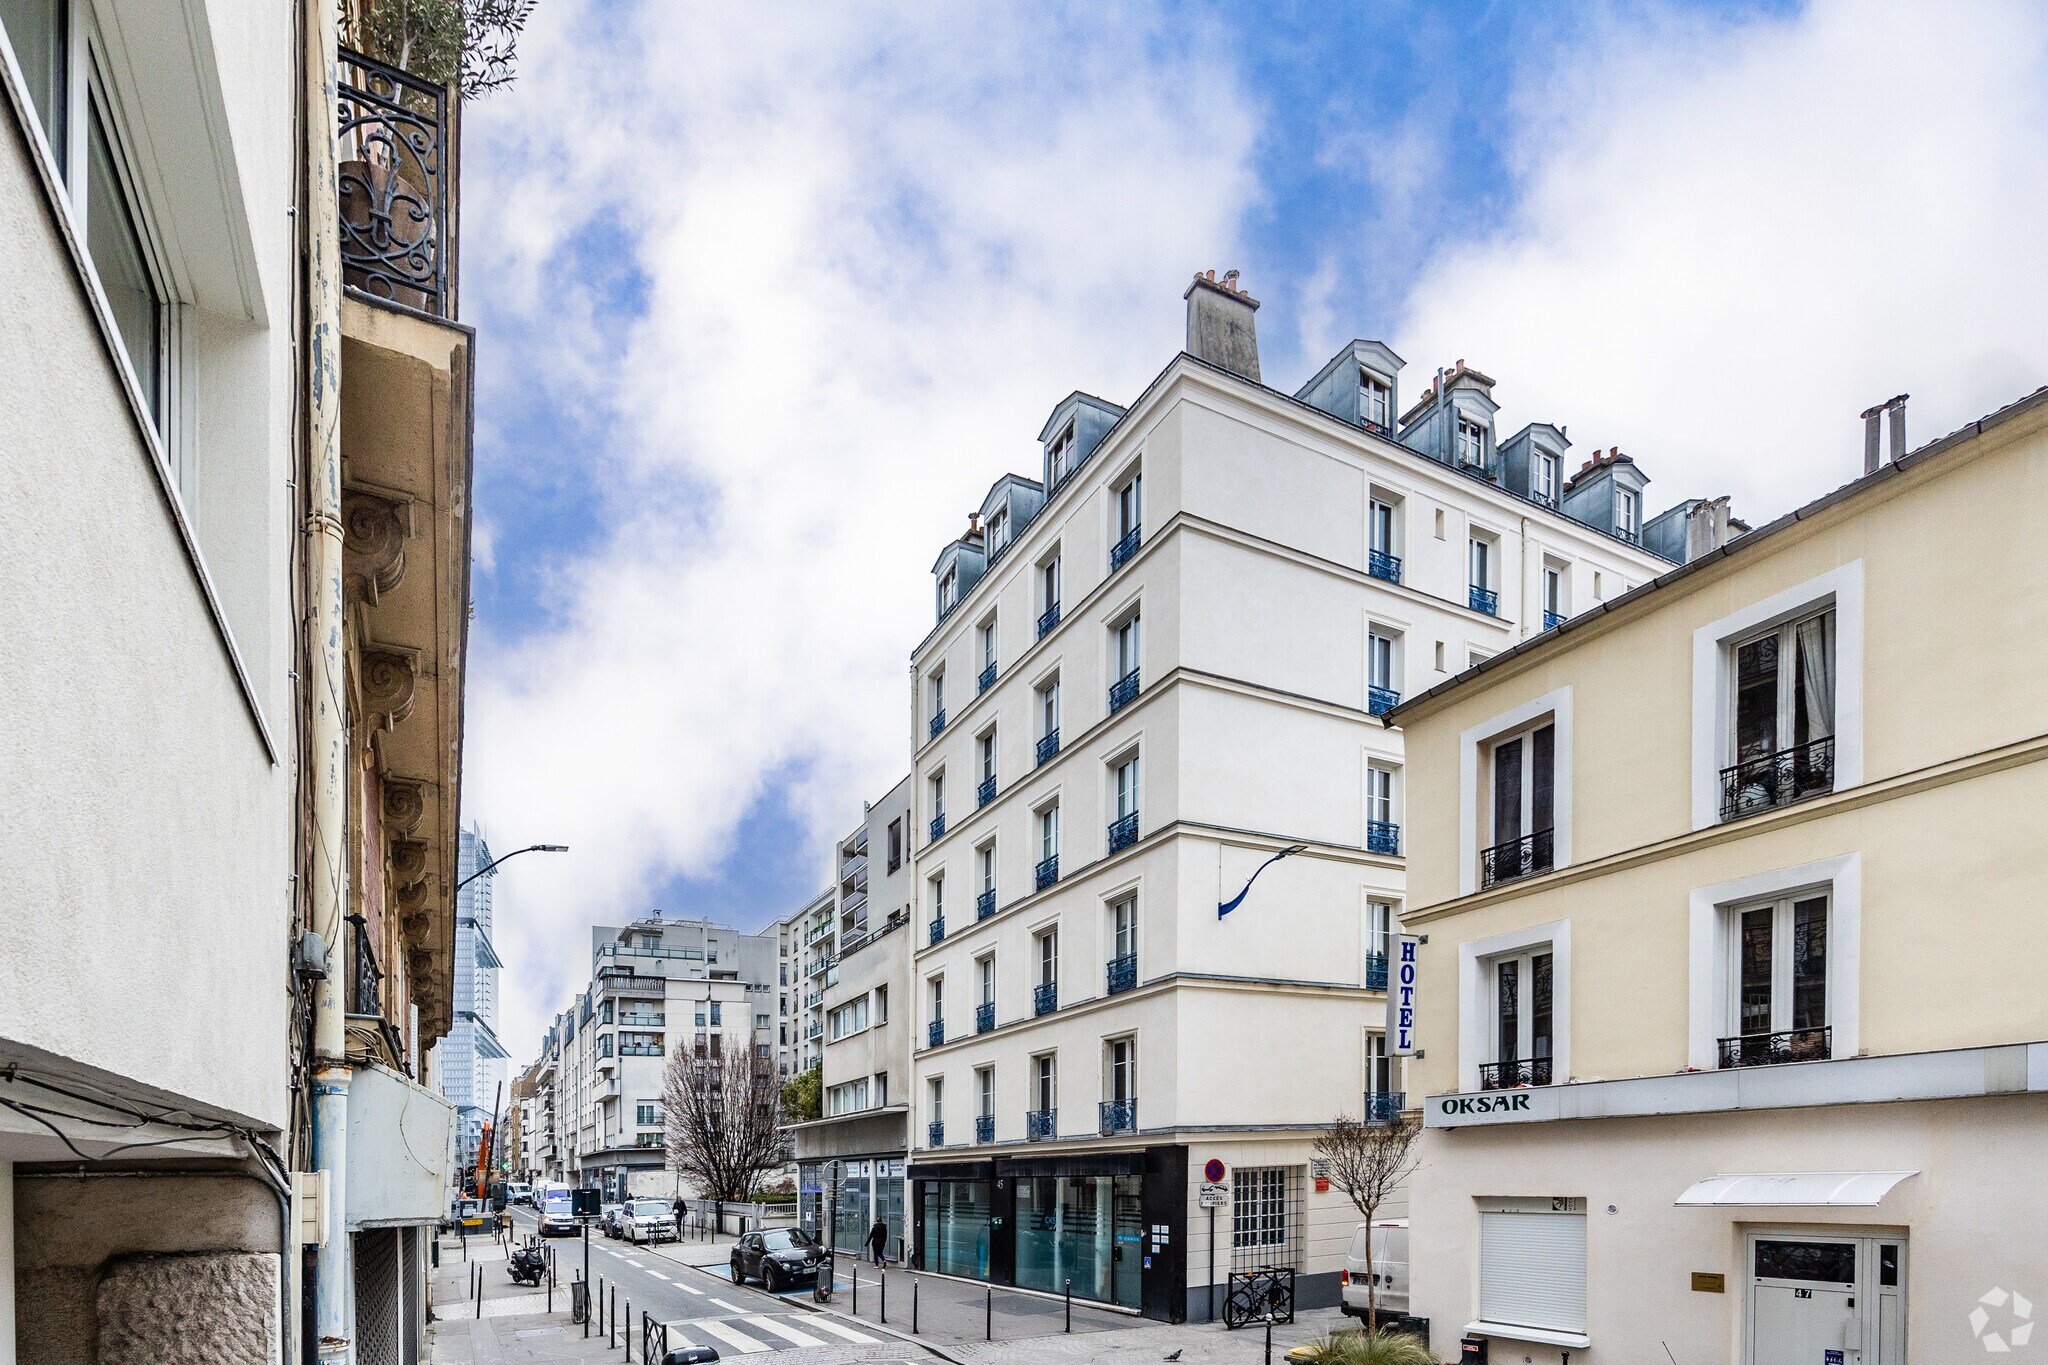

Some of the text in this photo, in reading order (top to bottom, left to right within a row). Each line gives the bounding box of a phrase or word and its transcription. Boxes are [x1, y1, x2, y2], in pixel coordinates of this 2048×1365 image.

[1399, 942, 1416, 1049] HOTEL
[1441, 1094, 1530, 1115] OKSAR
[996, 1179, 1004, 1190] 45
[1795, 1289, 1811, 1298] 47
